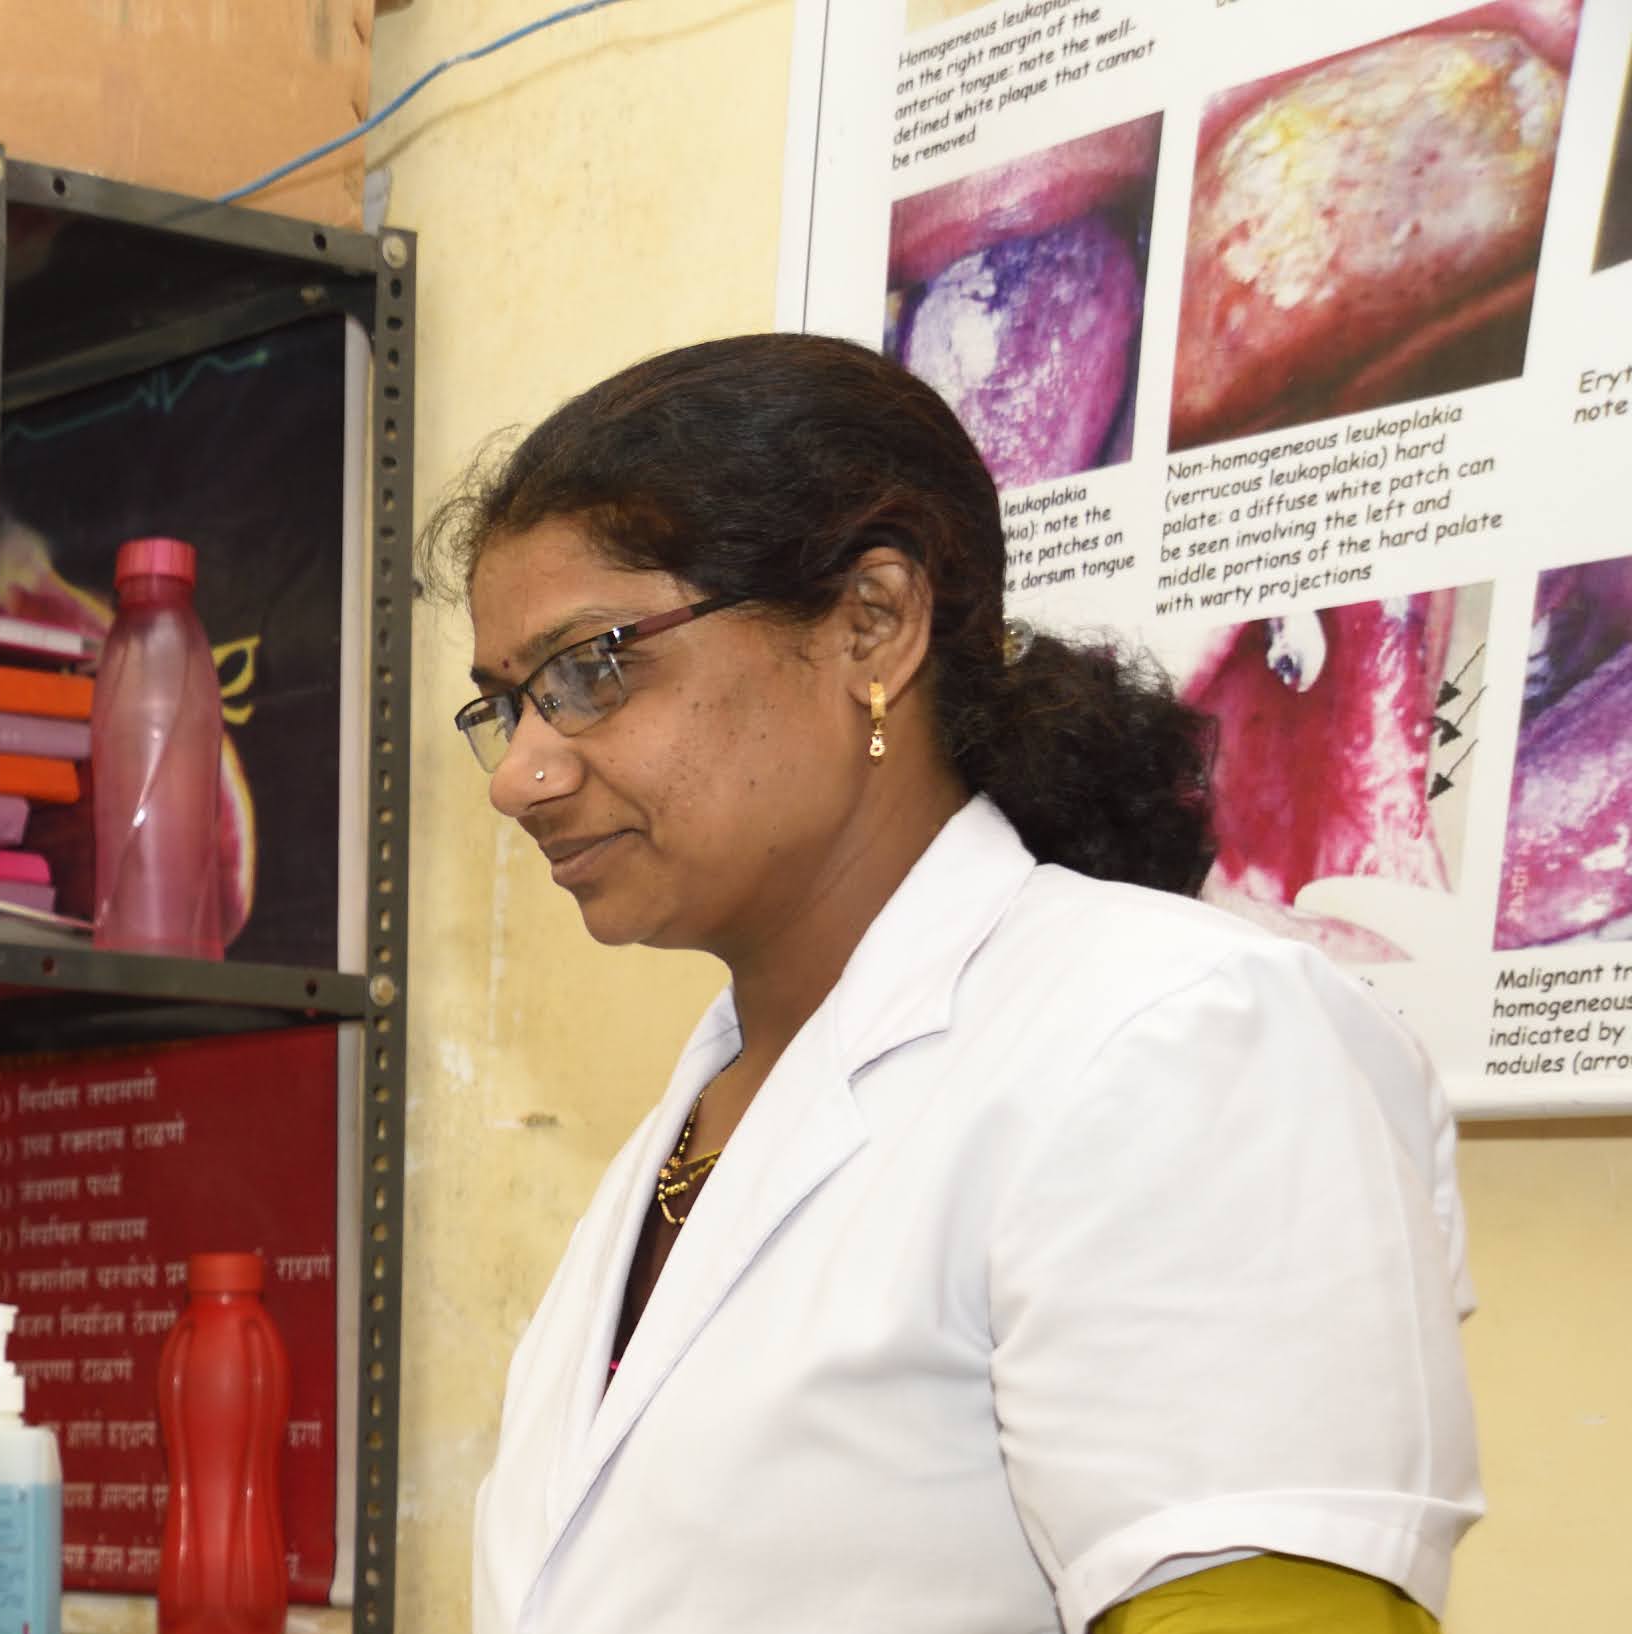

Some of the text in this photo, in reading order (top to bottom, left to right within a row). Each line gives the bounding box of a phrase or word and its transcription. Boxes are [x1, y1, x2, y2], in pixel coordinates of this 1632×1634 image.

[894, 88, 954, 121] anterior
[1019, 48, 1055, 72] note
[1062, 35, 1089, 57] the
[1095, 17, 1137, 46] well-
[896, 6, 1101, 95] on the right margin of the
[898, 20, 997, 71] Homogeneous
[893, 39, 1156, 146] defined white plaque that cannot
[891, 124, 976, 171] be removed
[1573, 399, 1629, 424] note
[1166, 405, 1463, 482] Non-homogeneous leukoplakia
[1161, 456, 1495, 540] palate: a diffuse white patch can
[1164, 433, 1446, 513] (verrucous leukoplakia) hard
[1004, 487, 1088, 518] leukoplakia
[1044, 515, 1078, 534] note
[1085, 506, 1112, 525] the
[1160, 490, 1451, 563] be seen involving the left and
[1021, 567, 1076, 590] dorsum
[1082, 555, 1135, 579] tongue
[1038, 535, 1099, 565] patches
[1104, 531, 1123, 546] on
[1157, 511, 1503, 590] middle portions of the hard palate
[1155, 562, 1372, 616] with warty projections
[1496, 965, 1604, 993] Malignant
[1489, 1021, 1625, 1047] indicated by
[1485, 1053, 1566, 1075] nodules
